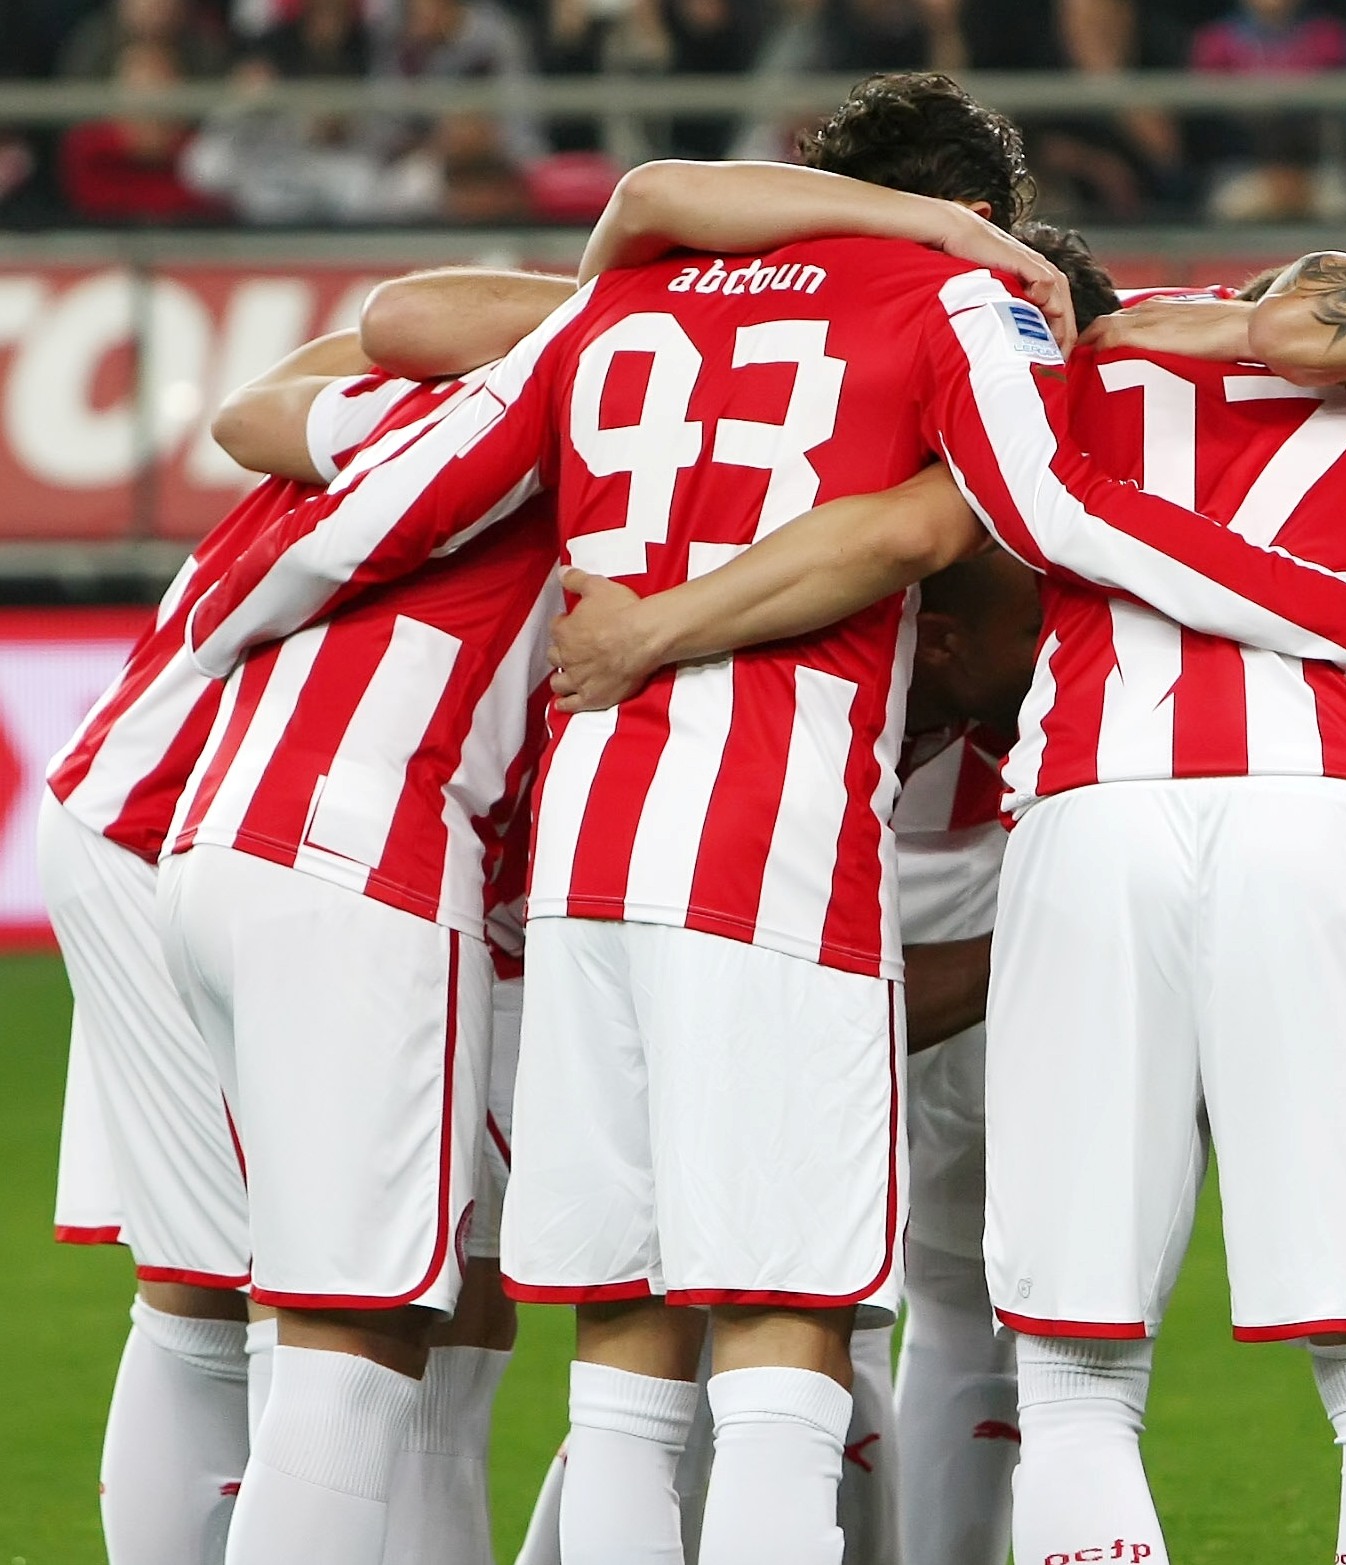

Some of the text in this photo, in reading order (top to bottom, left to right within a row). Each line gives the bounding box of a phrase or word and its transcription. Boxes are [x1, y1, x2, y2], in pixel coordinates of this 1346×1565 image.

[667, 258, 828, 296] abdoun
[567, 311, 847, 577] 93
[1044, 1539, 1151, 1565] ocfp
